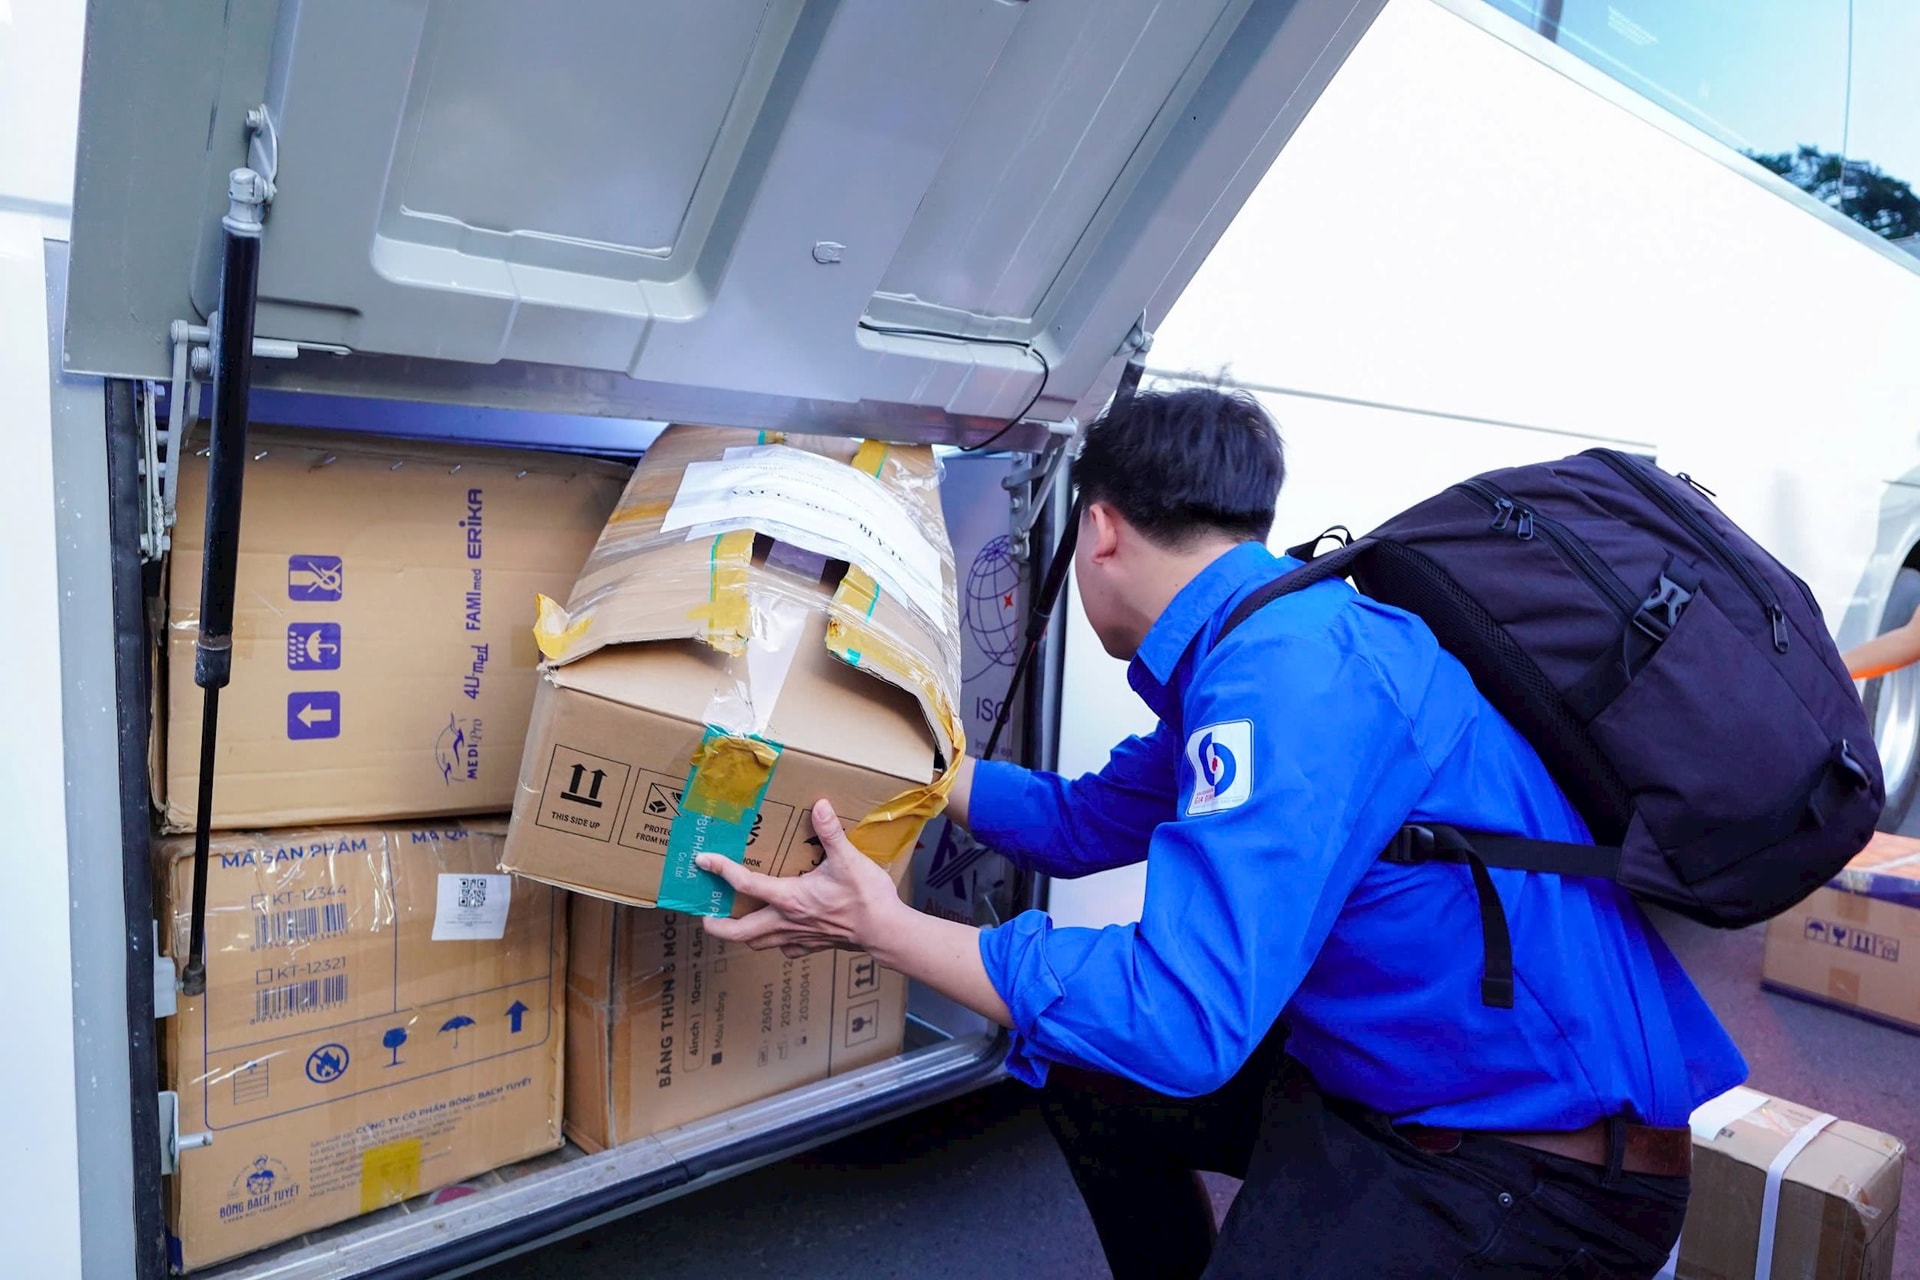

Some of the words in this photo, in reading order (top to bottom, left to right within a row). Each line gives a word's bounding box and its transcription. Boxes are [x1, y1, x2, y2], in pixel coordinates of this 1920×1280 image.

[551, 811, 569, 823] THIS
[570, 815, 588, 827] SIDE
[589, 821, 601, 830] UP
[643, 823, 673, 836] PROTEC
[635, 832, 658, 844] FROM
[658, 839, 669, 847] HE
[710, 891, 723, 906] BV
[661, 912, 677, 958] MÓC
[277, 956, 346, 979] KT-12321
[661, 978, 676, 1031] THUN
[780, 959, 794, 1028] 20250412
[762, 983, 774, 1034] 250401
[689, 1021, 700, 1057] 4inch
[656, 1036, 674, 1089] BĂNG
[388, 1115, 401, 1125] TY
